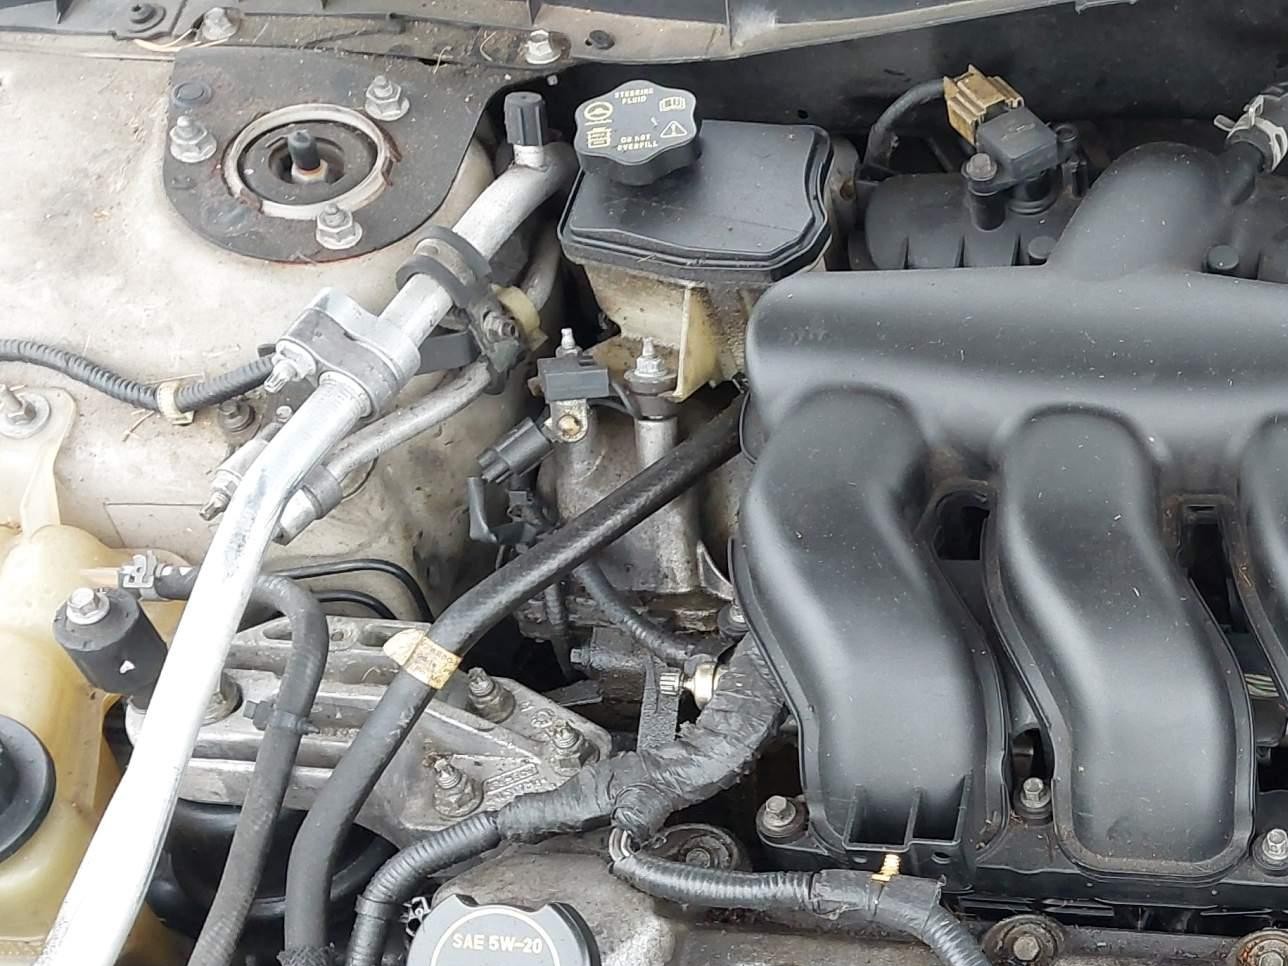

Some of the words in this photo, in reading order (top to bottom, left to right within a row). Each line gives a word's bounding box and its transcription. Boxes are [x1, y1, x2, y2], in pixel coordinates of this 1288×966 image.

[622, 96, 646, 104] FLUID
[452, 932, 485, 951] SAE
[488, 935, 543, 954] 5W-20
